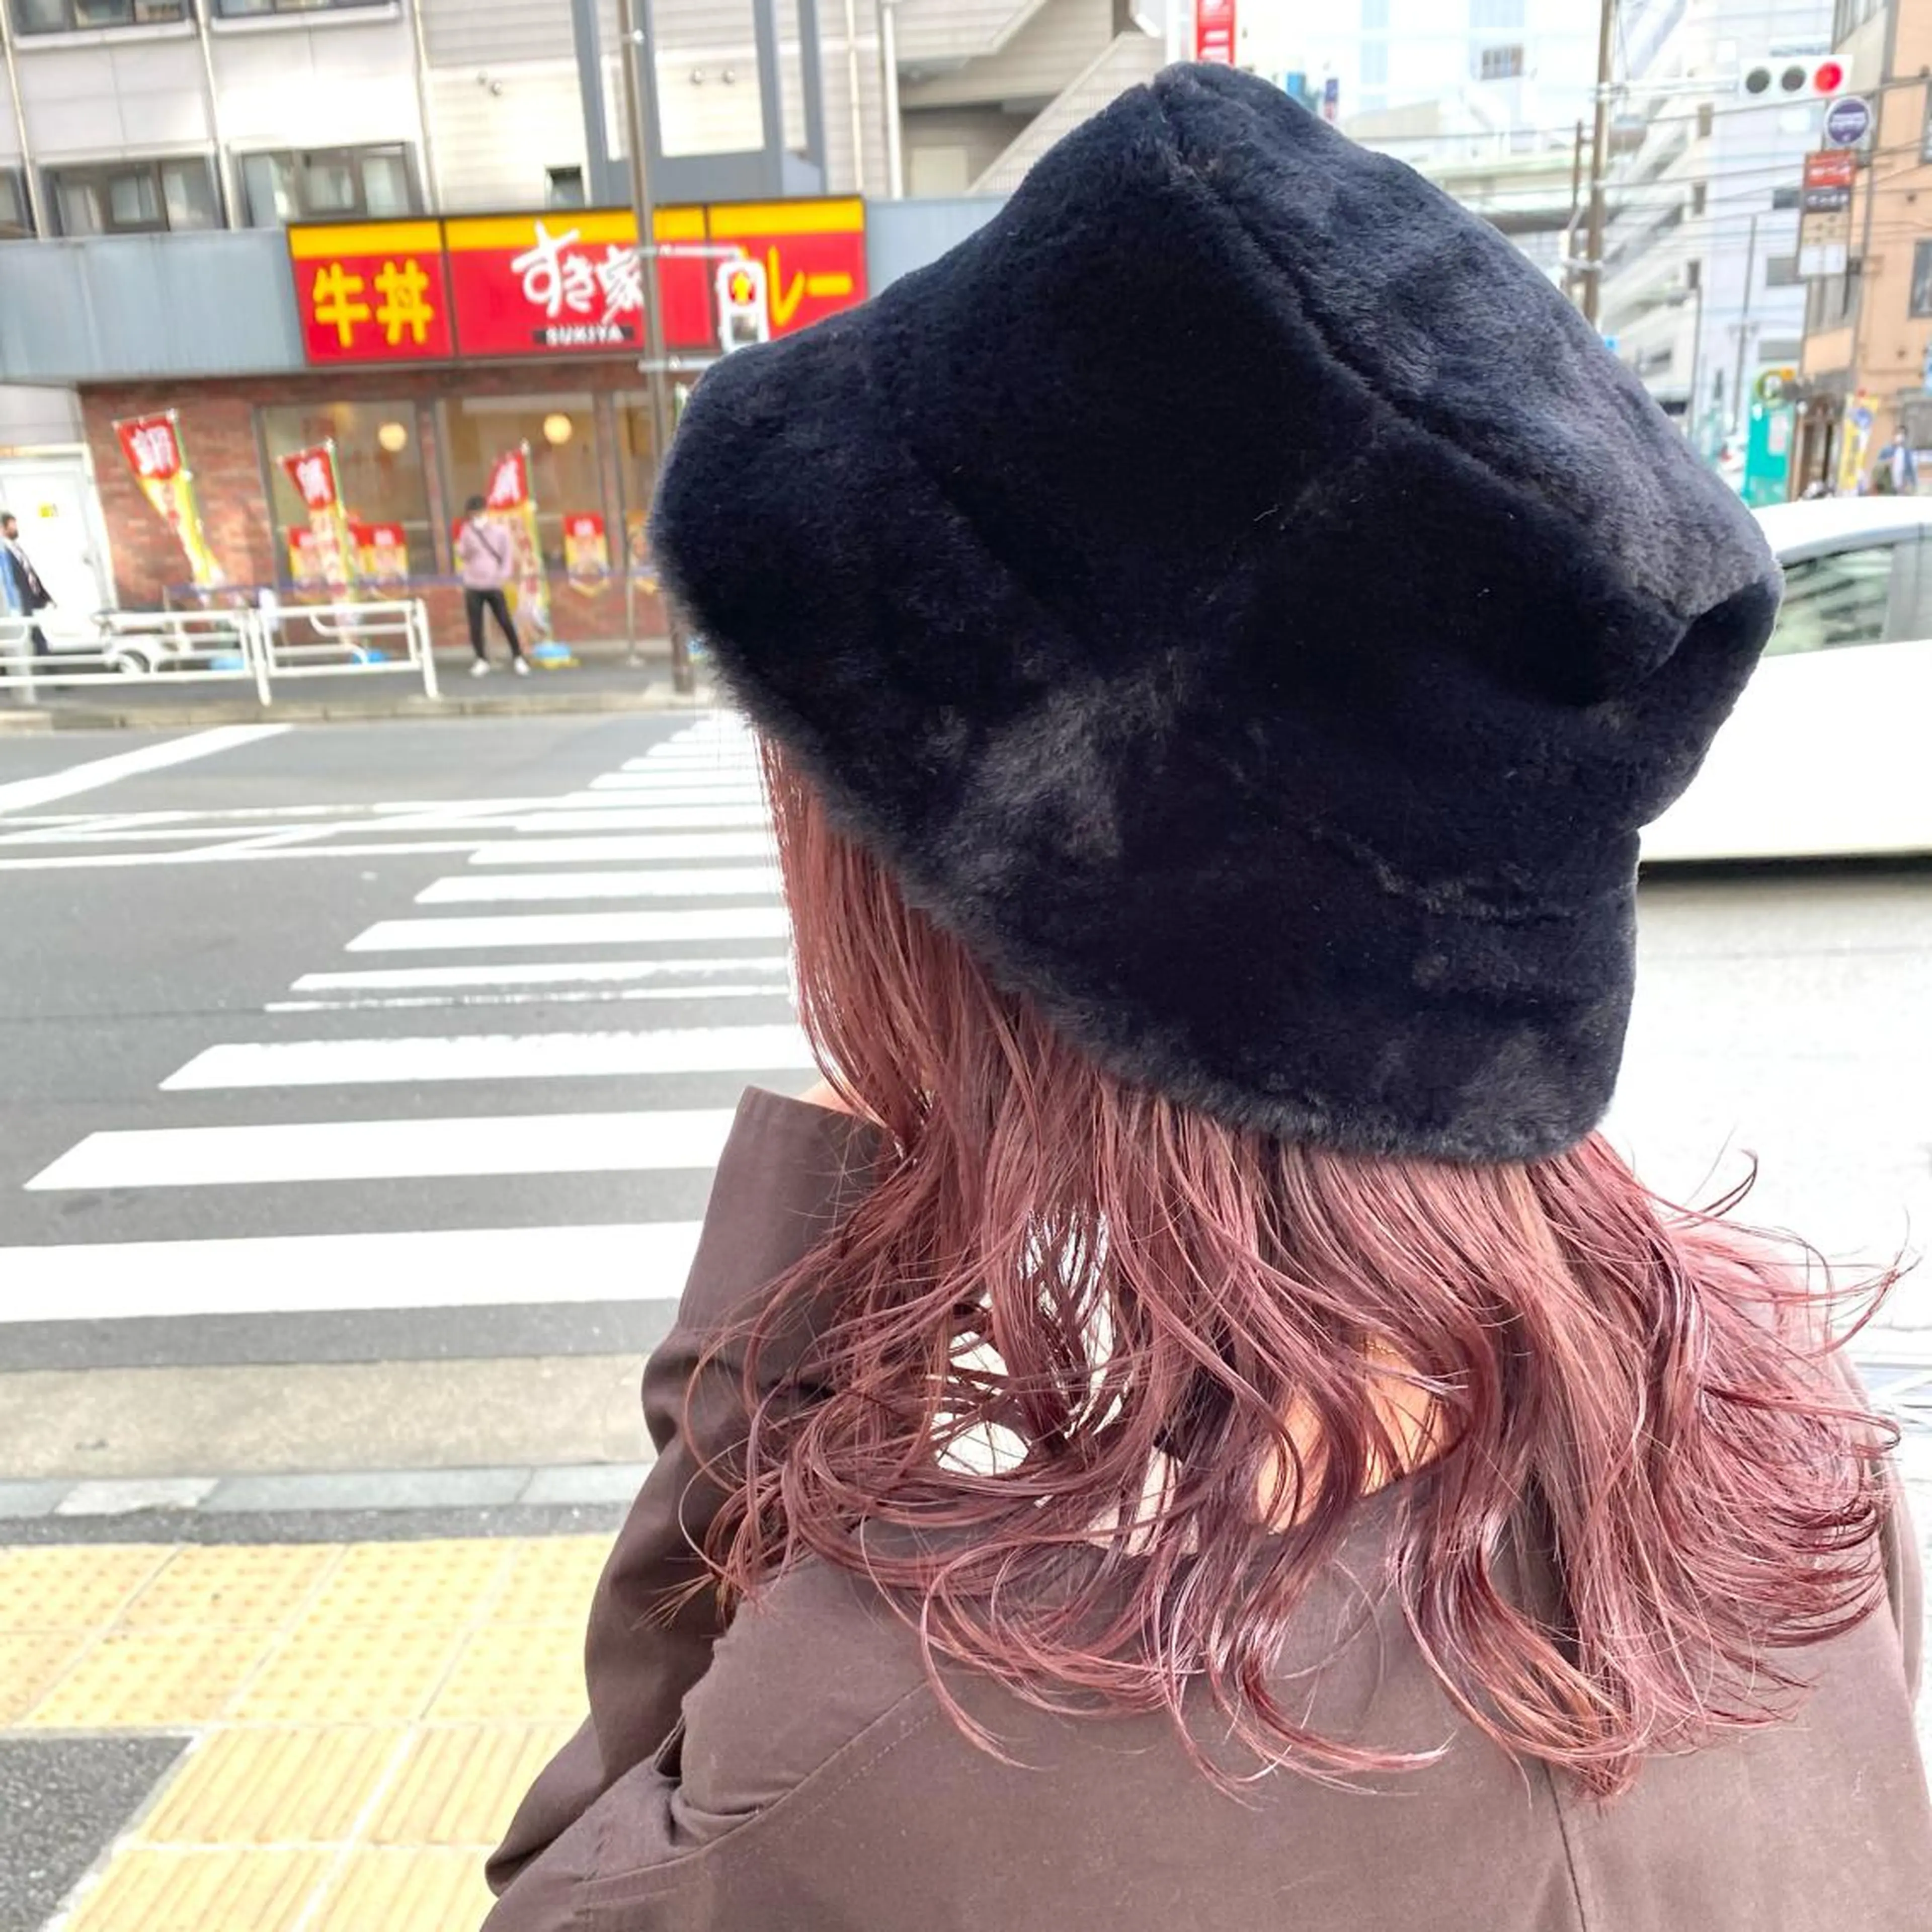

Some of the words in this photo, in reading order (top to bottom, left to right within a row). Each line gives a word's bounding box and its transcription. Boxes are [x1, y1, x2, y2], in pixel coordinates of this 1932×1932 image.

[313, 258, 434, 348] 牛丼
[511, 220, 644, 325] すき家
[731, 245, 852, 326] レー
[545, 323, 625, 346] SUKIYA
